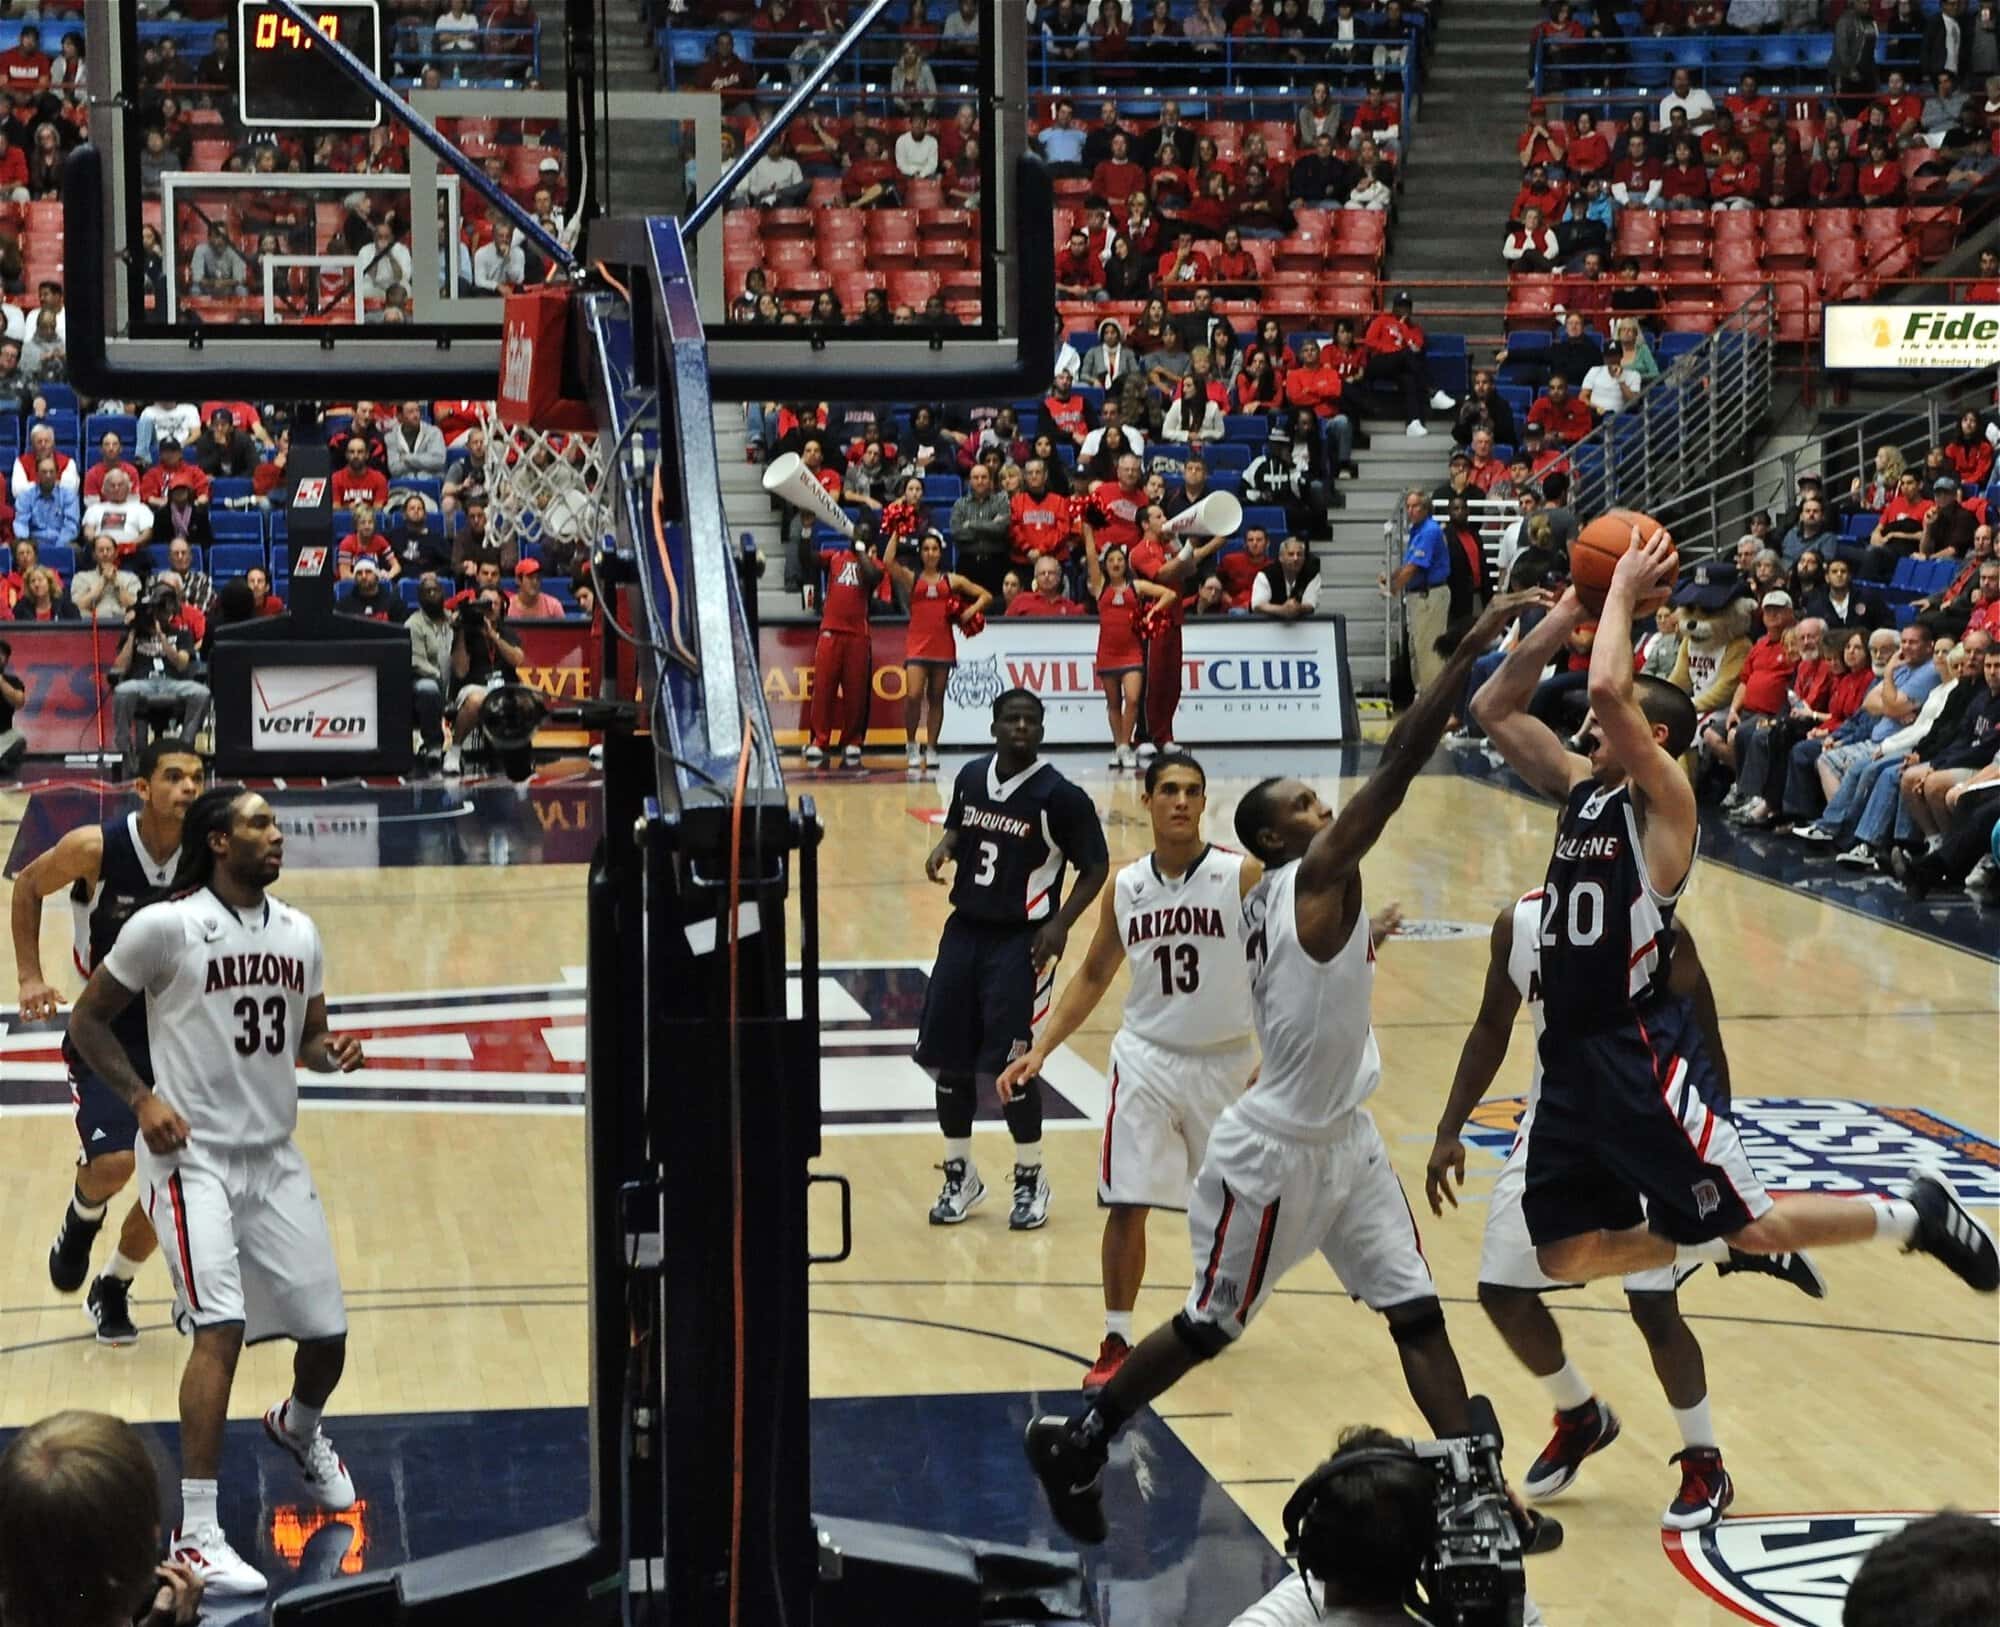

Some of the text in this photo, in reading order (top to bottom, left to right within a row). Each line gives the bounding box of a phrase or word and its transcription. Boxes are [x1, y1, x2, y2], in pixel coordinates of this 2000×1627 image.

[259, 711, 367, 739] verizon
[974, 841, 998, 888] 3
[1127, 906, 1226, 947] ARIZONA
[1540, 882, 1605, 946] 20
[204, 953, 305, 995] ARIZONA
[1153, 943, 1200, 996] 13
[233, 996, 287, 1057] 33
